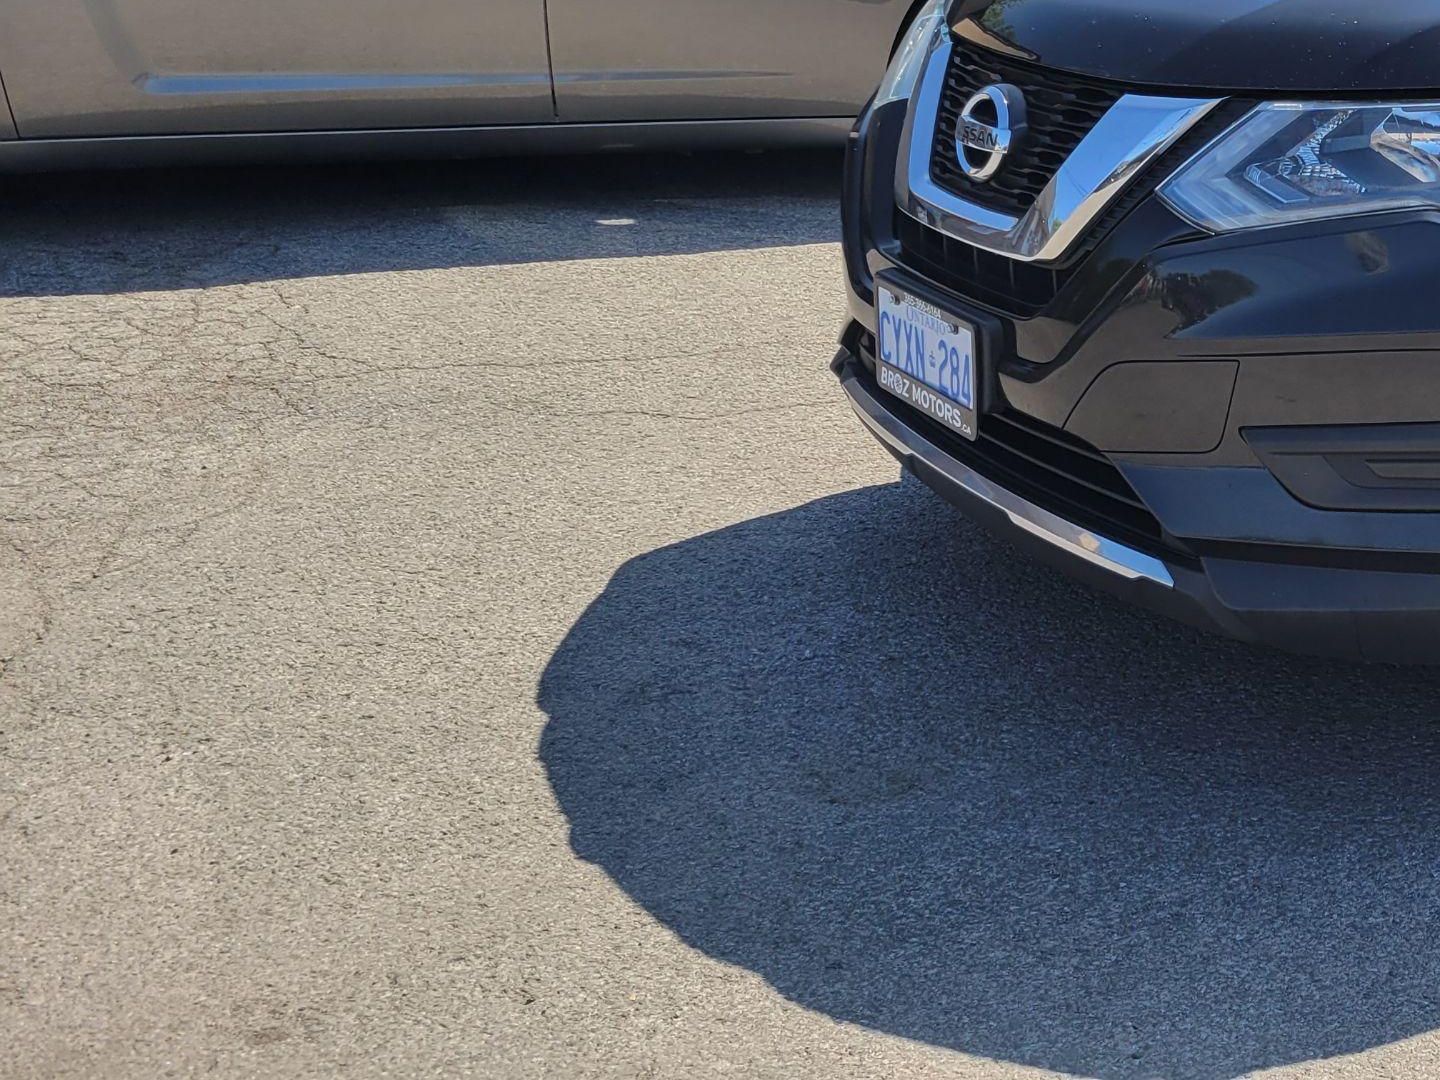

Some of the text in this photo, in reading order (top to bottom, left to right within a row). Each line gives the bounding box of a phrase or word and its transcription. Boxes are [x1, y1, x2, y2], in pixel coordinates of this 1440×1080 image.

[960, 125, 999, 147] SSAN
[880, 310, 972, 409] CYXN 284
